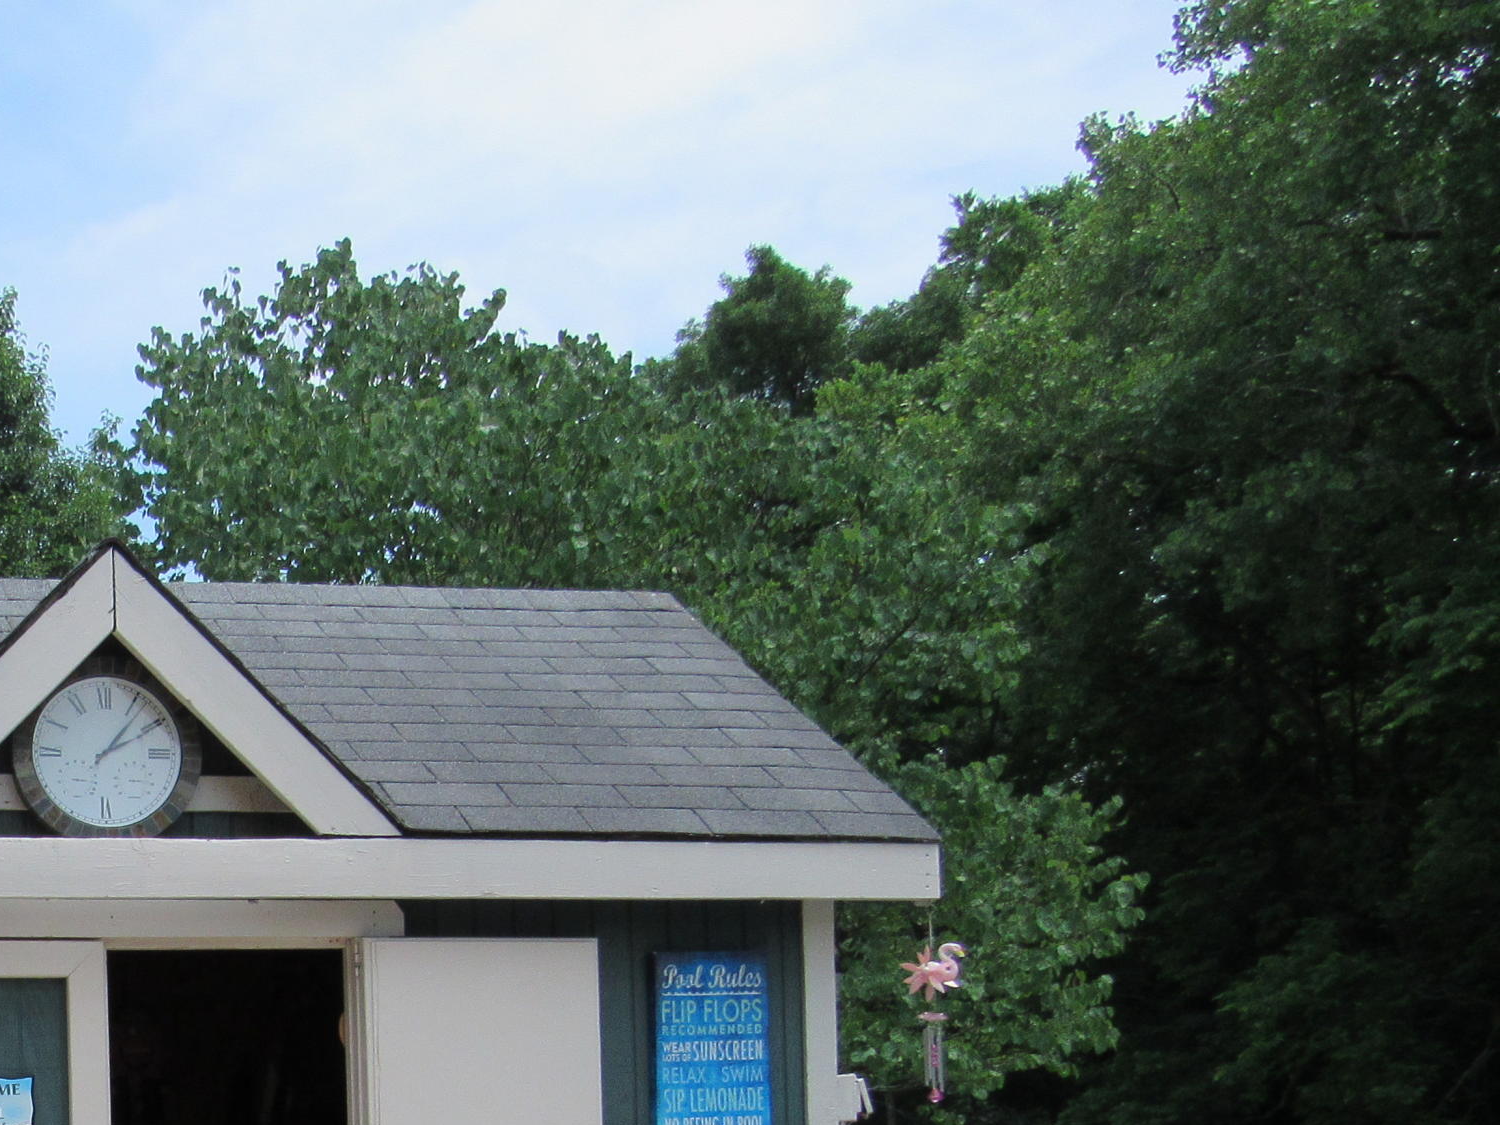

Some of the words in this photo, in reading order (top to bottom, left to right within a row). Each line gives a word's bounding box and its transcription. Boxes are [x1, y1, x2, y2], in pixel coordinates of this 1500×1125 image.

[662, 964, 704, 989] Pool
[708, 964, 761, 988] Rules
[662, 1001, 697, 1023] FLIP
[703, 999, 762, 1022] FLOPS
[662, 1024, 763, 1036] RECOMMENDED
[662, 1042, 691, 1053] WEAR
[693, 1040, 763, 1060] SUNSCREEN
[663, 1053, 681, 1062] LOTS
[682, 1053, 691, 1062] OF
[663, 1066, 706, 1084] RELAX
[721, 1066, 764, 1083] SWIM
[664, 1089, 685, 1113] SIP
[690, 1087, 764, 1112] LEMONADE
